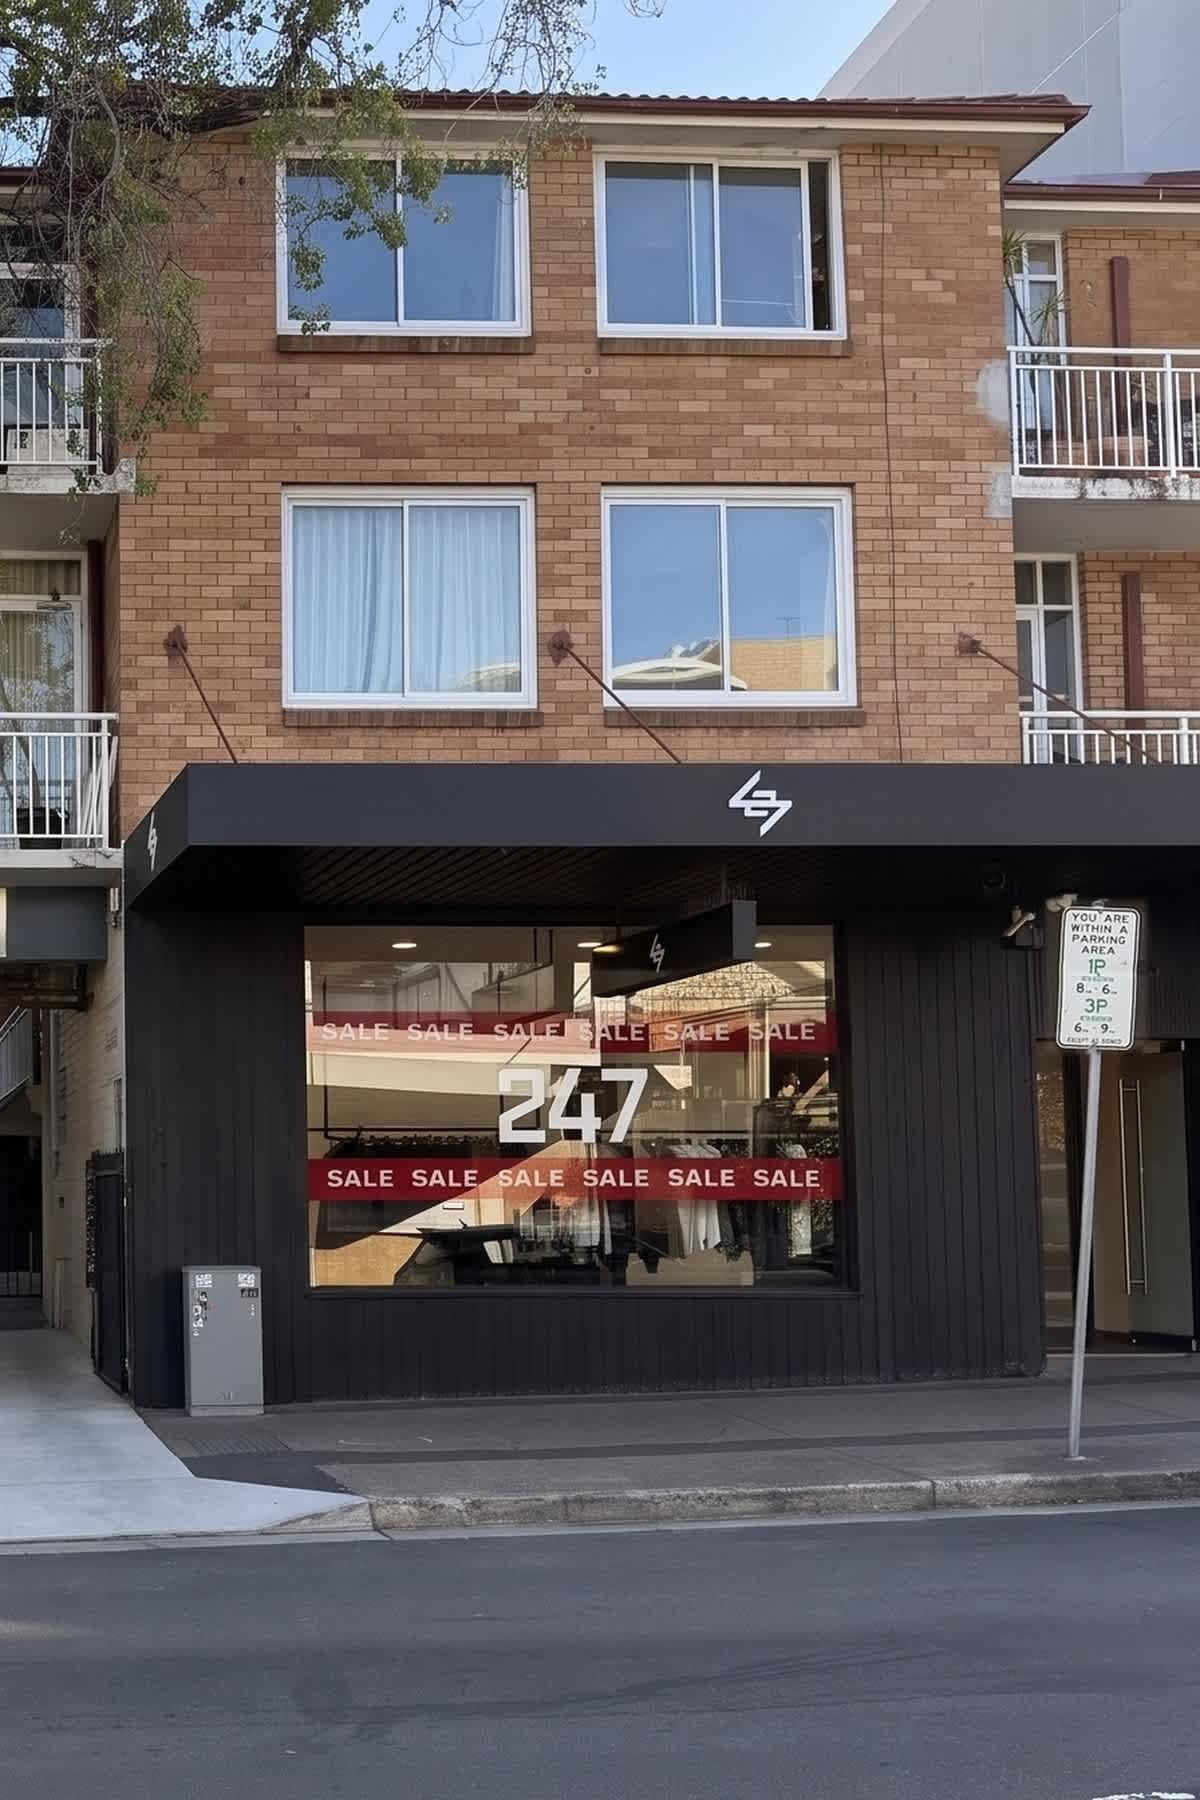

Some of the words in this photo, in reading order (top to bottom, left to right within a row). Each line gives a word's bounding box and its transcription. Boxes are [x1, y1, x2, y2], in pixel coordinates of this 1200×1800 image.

[1072, 913, 1097, 922] YOU
[1104, 914, 1129, 924] ARE
[1071, 924, 1112, 933] WITHIN
[1119, 925, 1128, 934] A
[1072, 934, 1126, 944] PARKING
[1081, 945, 1115, 955] AREA
[1089, 959, 1106, 974] 1P
[1084, 998, 1108, 1013] 3P
[321, 1023, 389, 1041] SALE
[407, 1023, 473, 1041] SALE
[494, 1023, 560, 1041] SALE
[579, 1023, 645, 1041] SALE
[664, 1023, 730, 1041] SALE
[750, 1022, 816, 1041] SALE
[499, 1068, 648, 1143] 247
[327, 1169, 393, 1188] SALE
[411, 1169, 478, 1188] SALE
[498, 1169, 564, 1188] SALE
[583, 1169, 649, 1188] SALE
[668, 1169, 735, 1188] SALE
[753, 1169, 820, 1188] SALE
